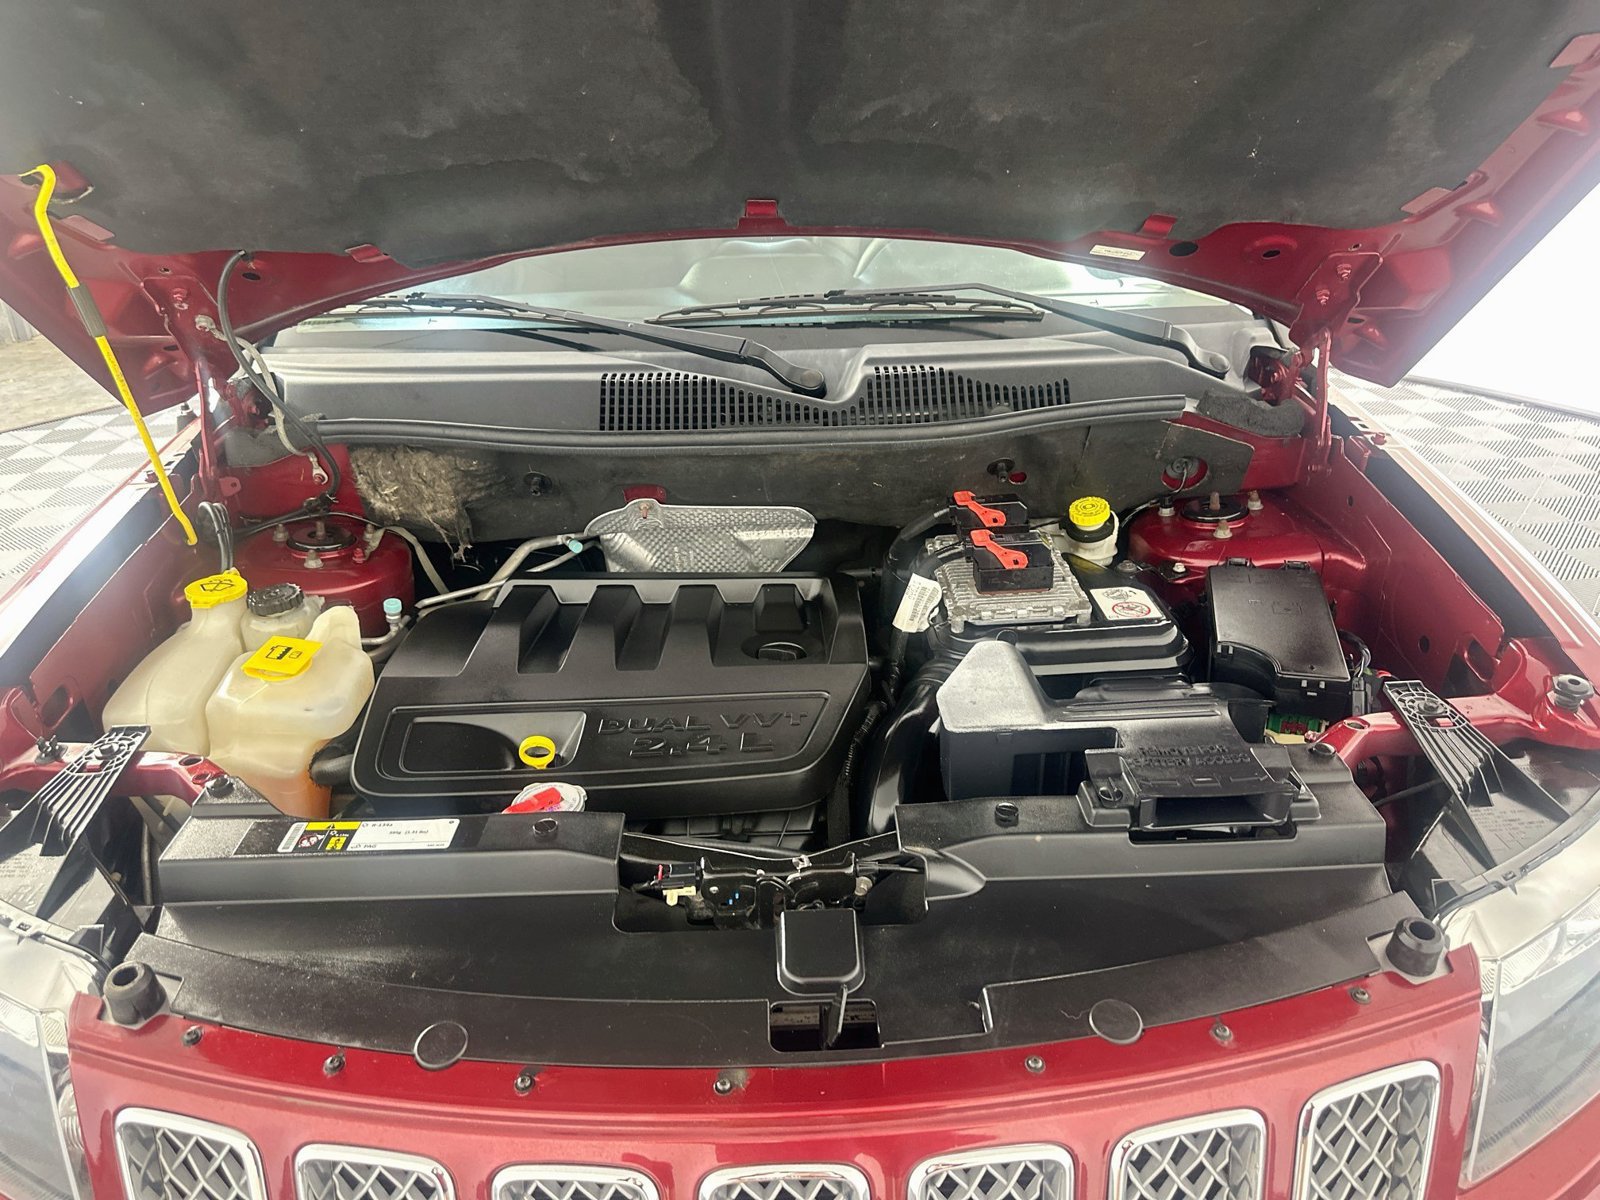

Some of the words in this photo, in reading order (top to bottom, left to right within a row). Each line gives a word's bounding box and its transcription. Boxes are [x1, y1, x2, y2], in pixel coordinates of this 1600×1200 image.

[598, 715, 712, 734] DUAL
[720, 711, 809, 729] VVT
[629, 734, 728, 757] 2.4
[739, 732, 775, 752] L
